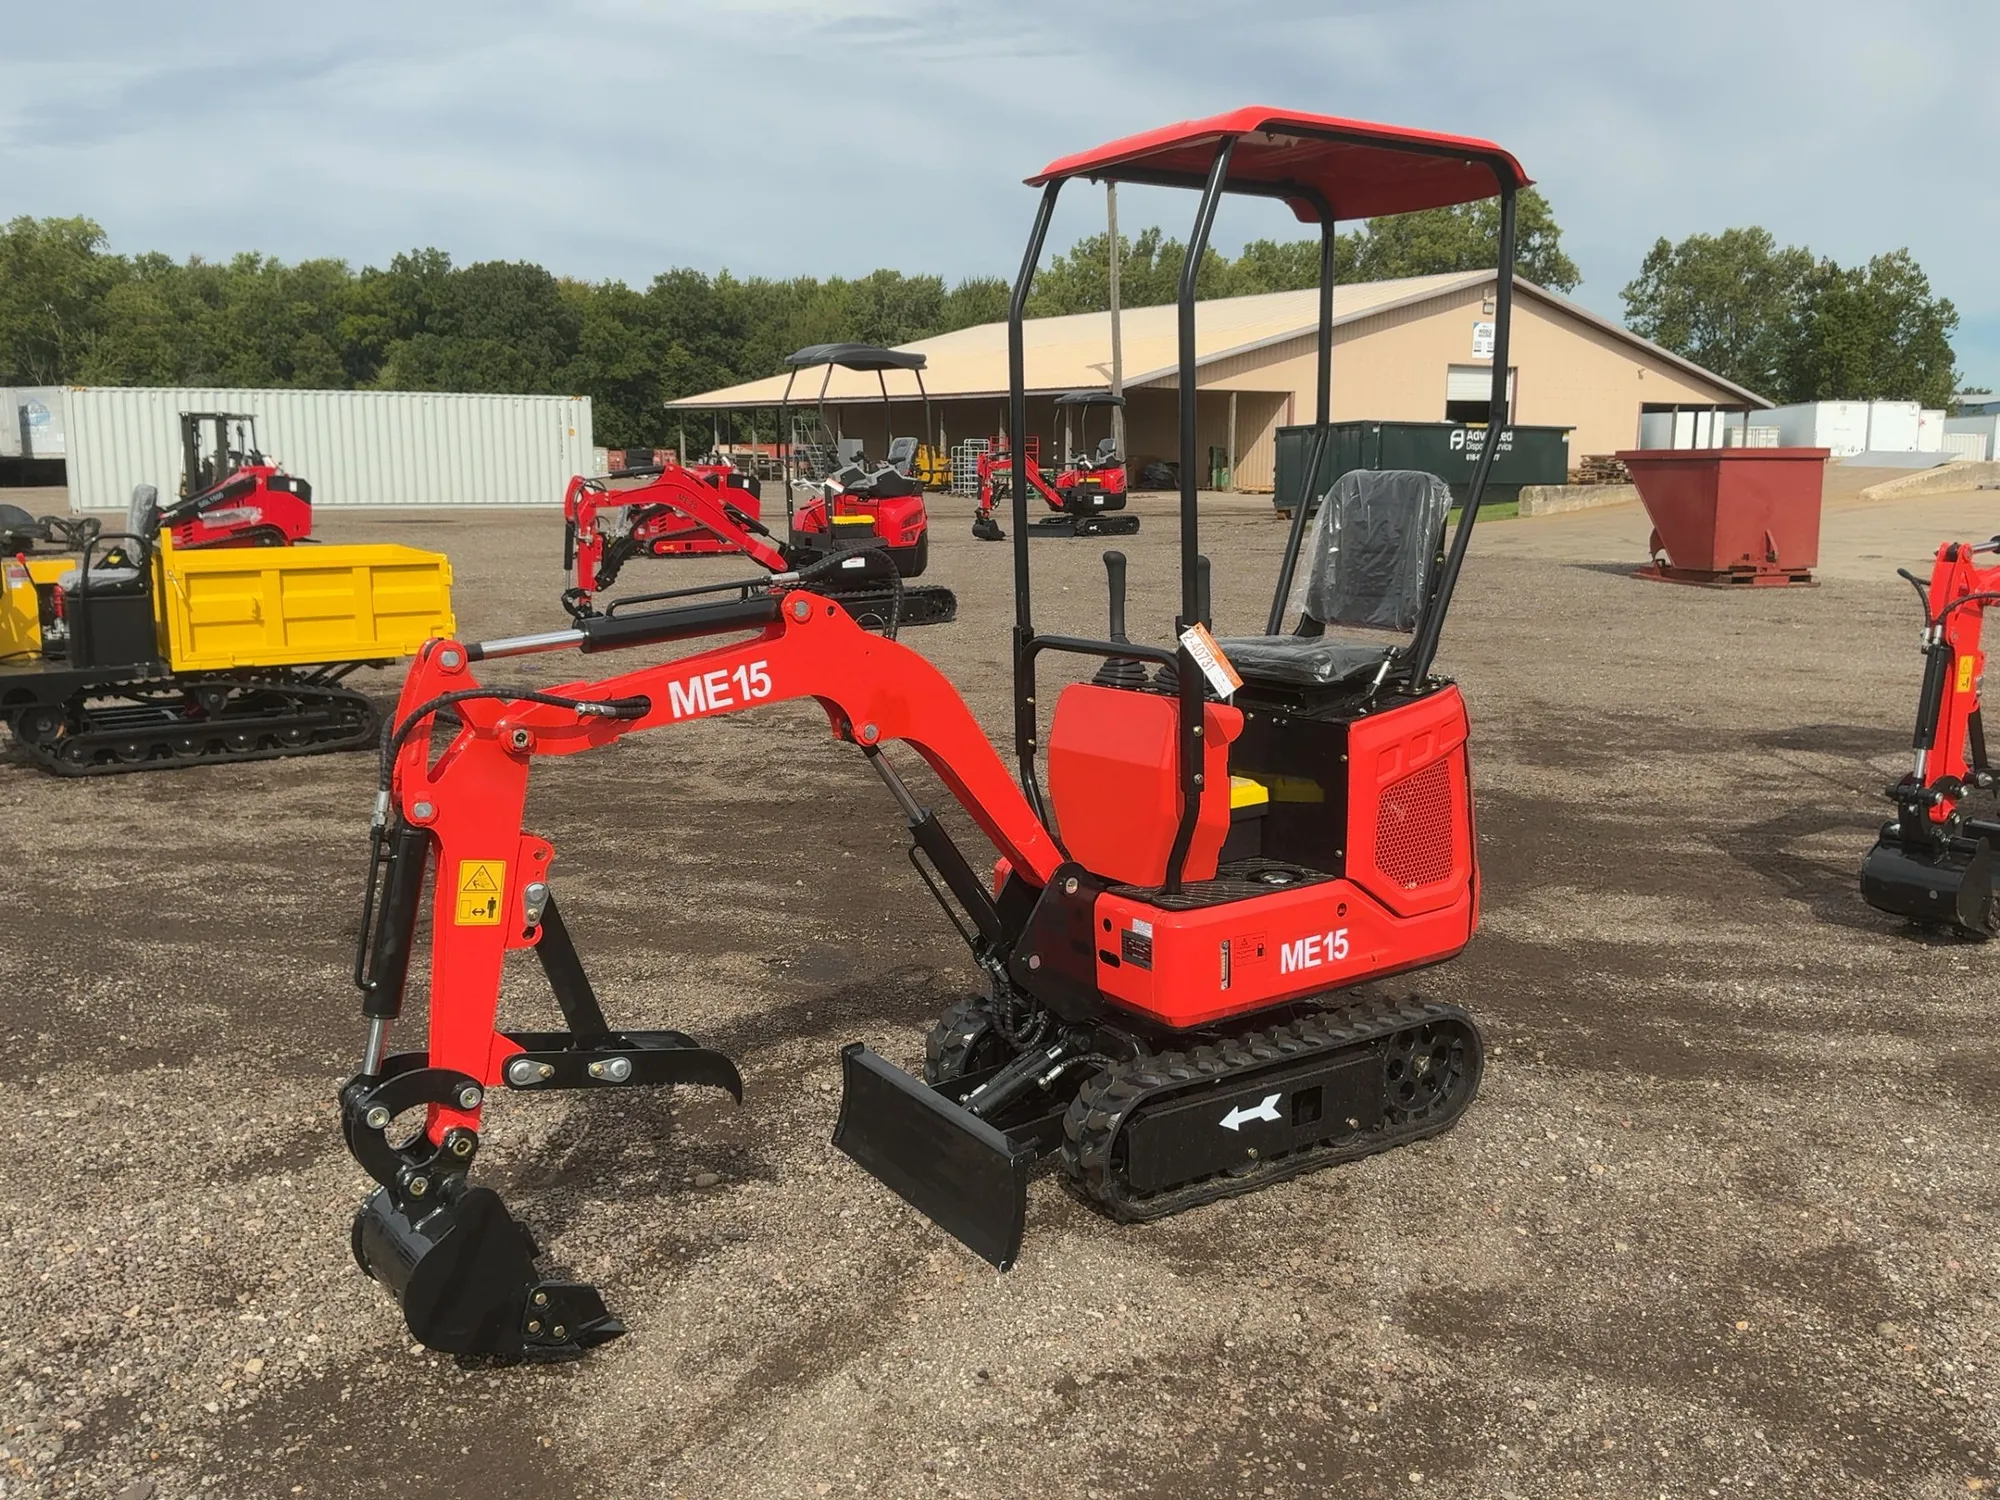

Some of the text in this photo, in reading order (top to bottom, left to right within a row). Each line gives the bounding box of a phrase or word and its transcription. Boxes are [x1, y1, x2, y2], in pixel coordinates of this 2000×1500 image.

[1466, 429, 1513, 442] Adved
[1182, 631, 1217, 672] 2-40731
[668, 660, 772, 718] ME15
[1280, 928, 1349, 975] ME15
